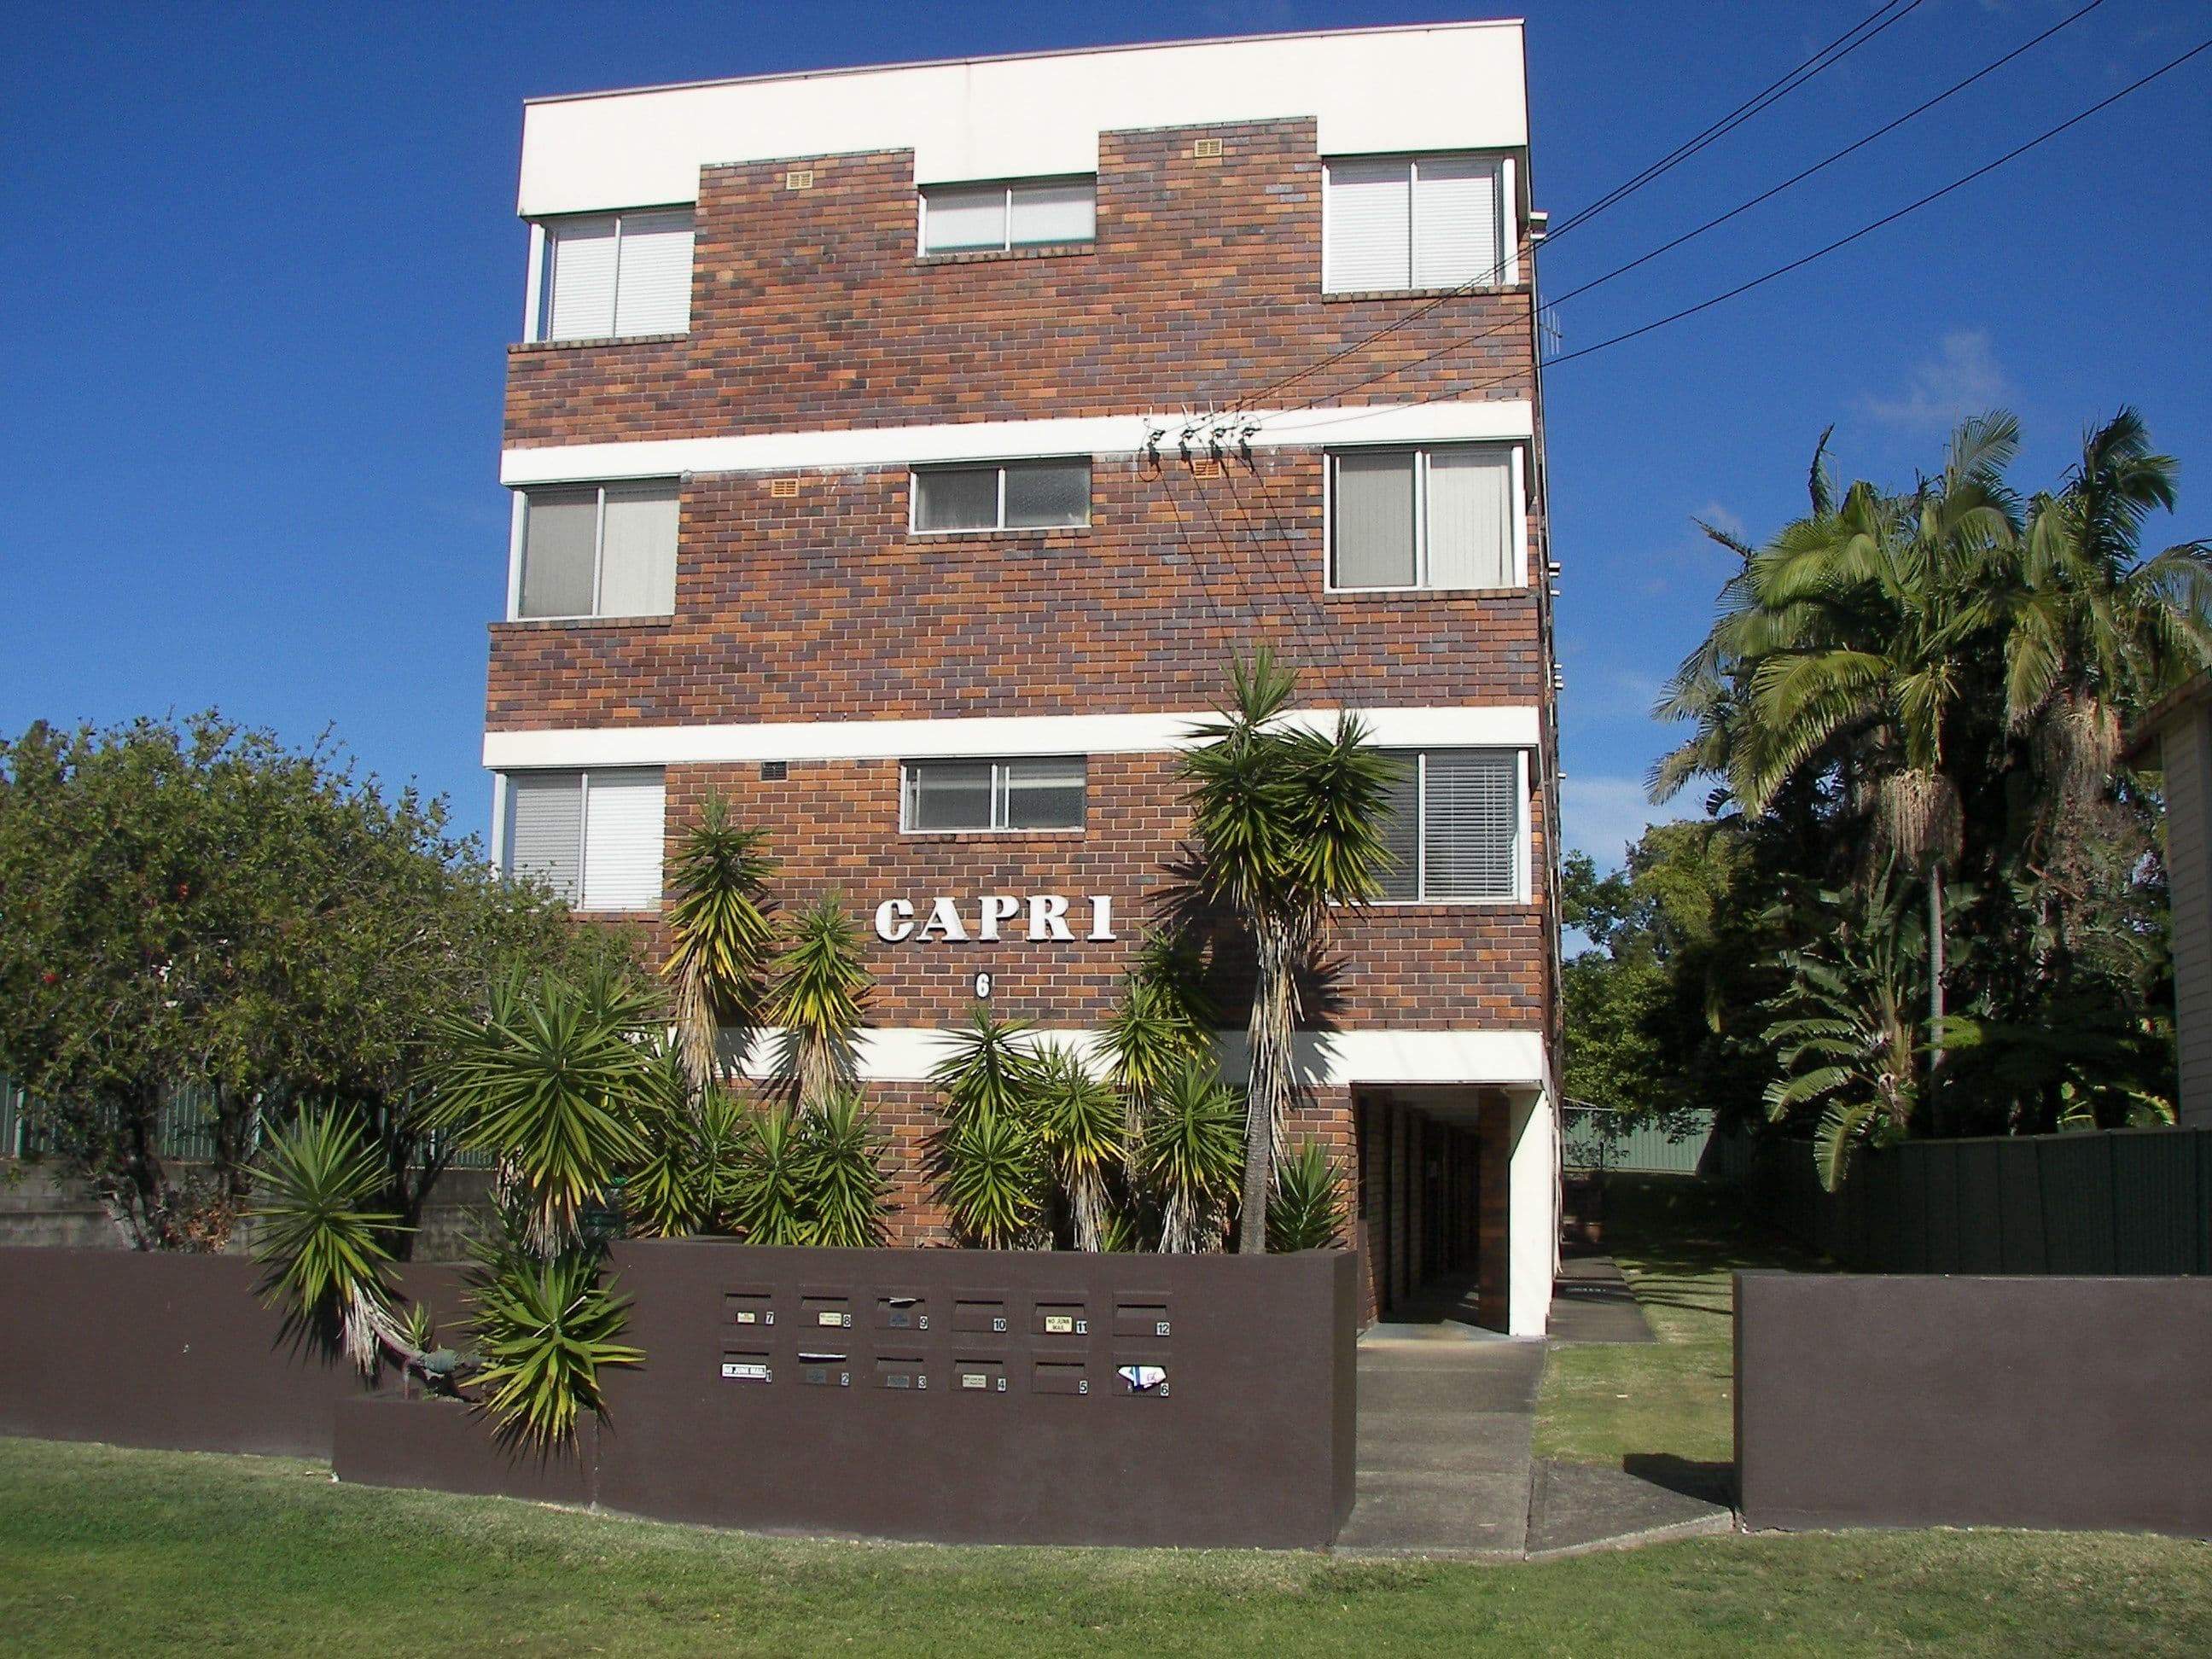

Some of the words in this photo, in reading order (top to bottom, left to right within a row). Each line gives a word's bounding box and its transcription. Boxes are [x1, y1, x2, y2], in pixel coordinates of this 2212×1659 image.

[874, 894, 1117, 942] CAPRI
[975, 972, 991, 998] 6
[766, 1313, 774, 1323] 7
[844, 1316, 851, 1326] 8
[920, 1318, 928, 1328] 9
[995, 1319, 1006, 1330] 10
[1078, 1322, 1087, 1332] 11
[1158, 1324, 1169, 1334] 12
[841, 1374, 849, 1384] 2
[918, 1377, 926, 1387] 3
[998, 1379, 1004, 1389] 4
[1080, 1382, 1087, 1392] 5
[1161, 1384, 1167, 1394] 6
